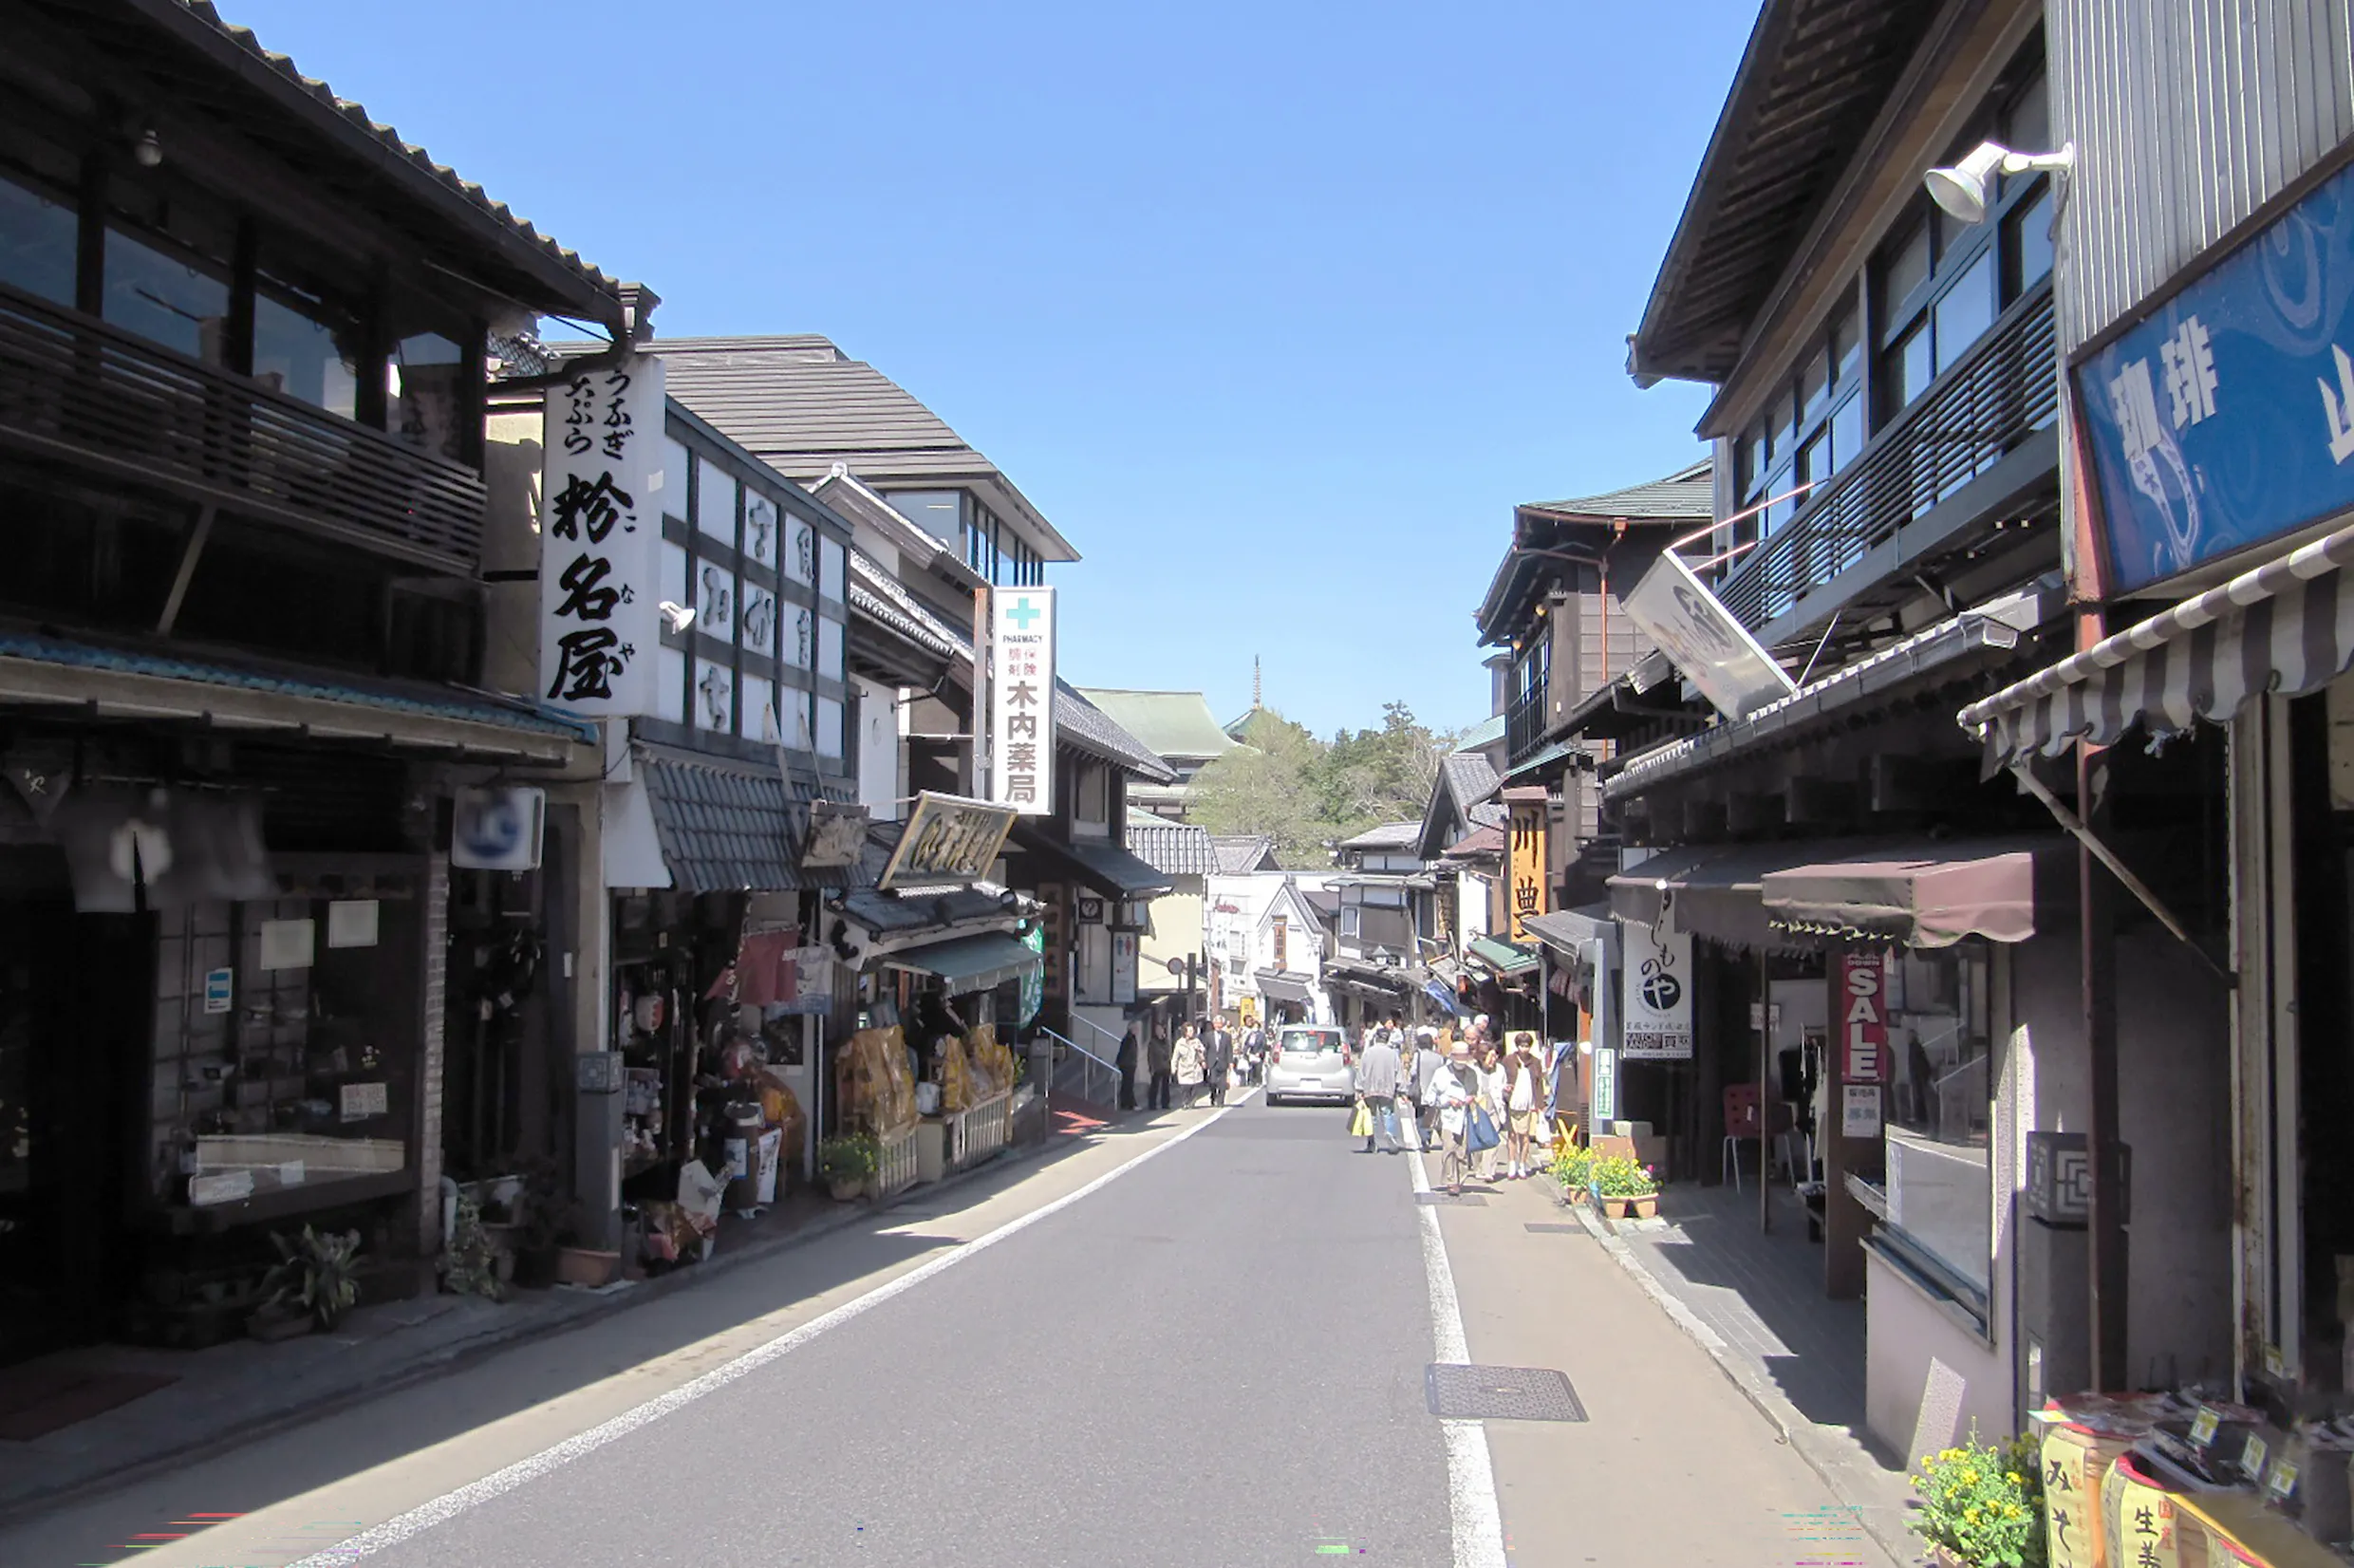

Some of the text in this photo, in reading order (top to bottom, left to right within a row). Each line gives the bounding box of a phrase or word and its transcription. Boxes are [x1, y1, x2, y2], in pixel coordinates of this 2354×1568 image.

[547, 471, 634, 700] 粉名屋
[1002, 635, 1042, 644] PHARMACY
[1005, 681, 1037, 804] 木内薬局
[1847, 969, 1879, 1079] SALE
[2046, 1459, 2072, 1568] みそ
